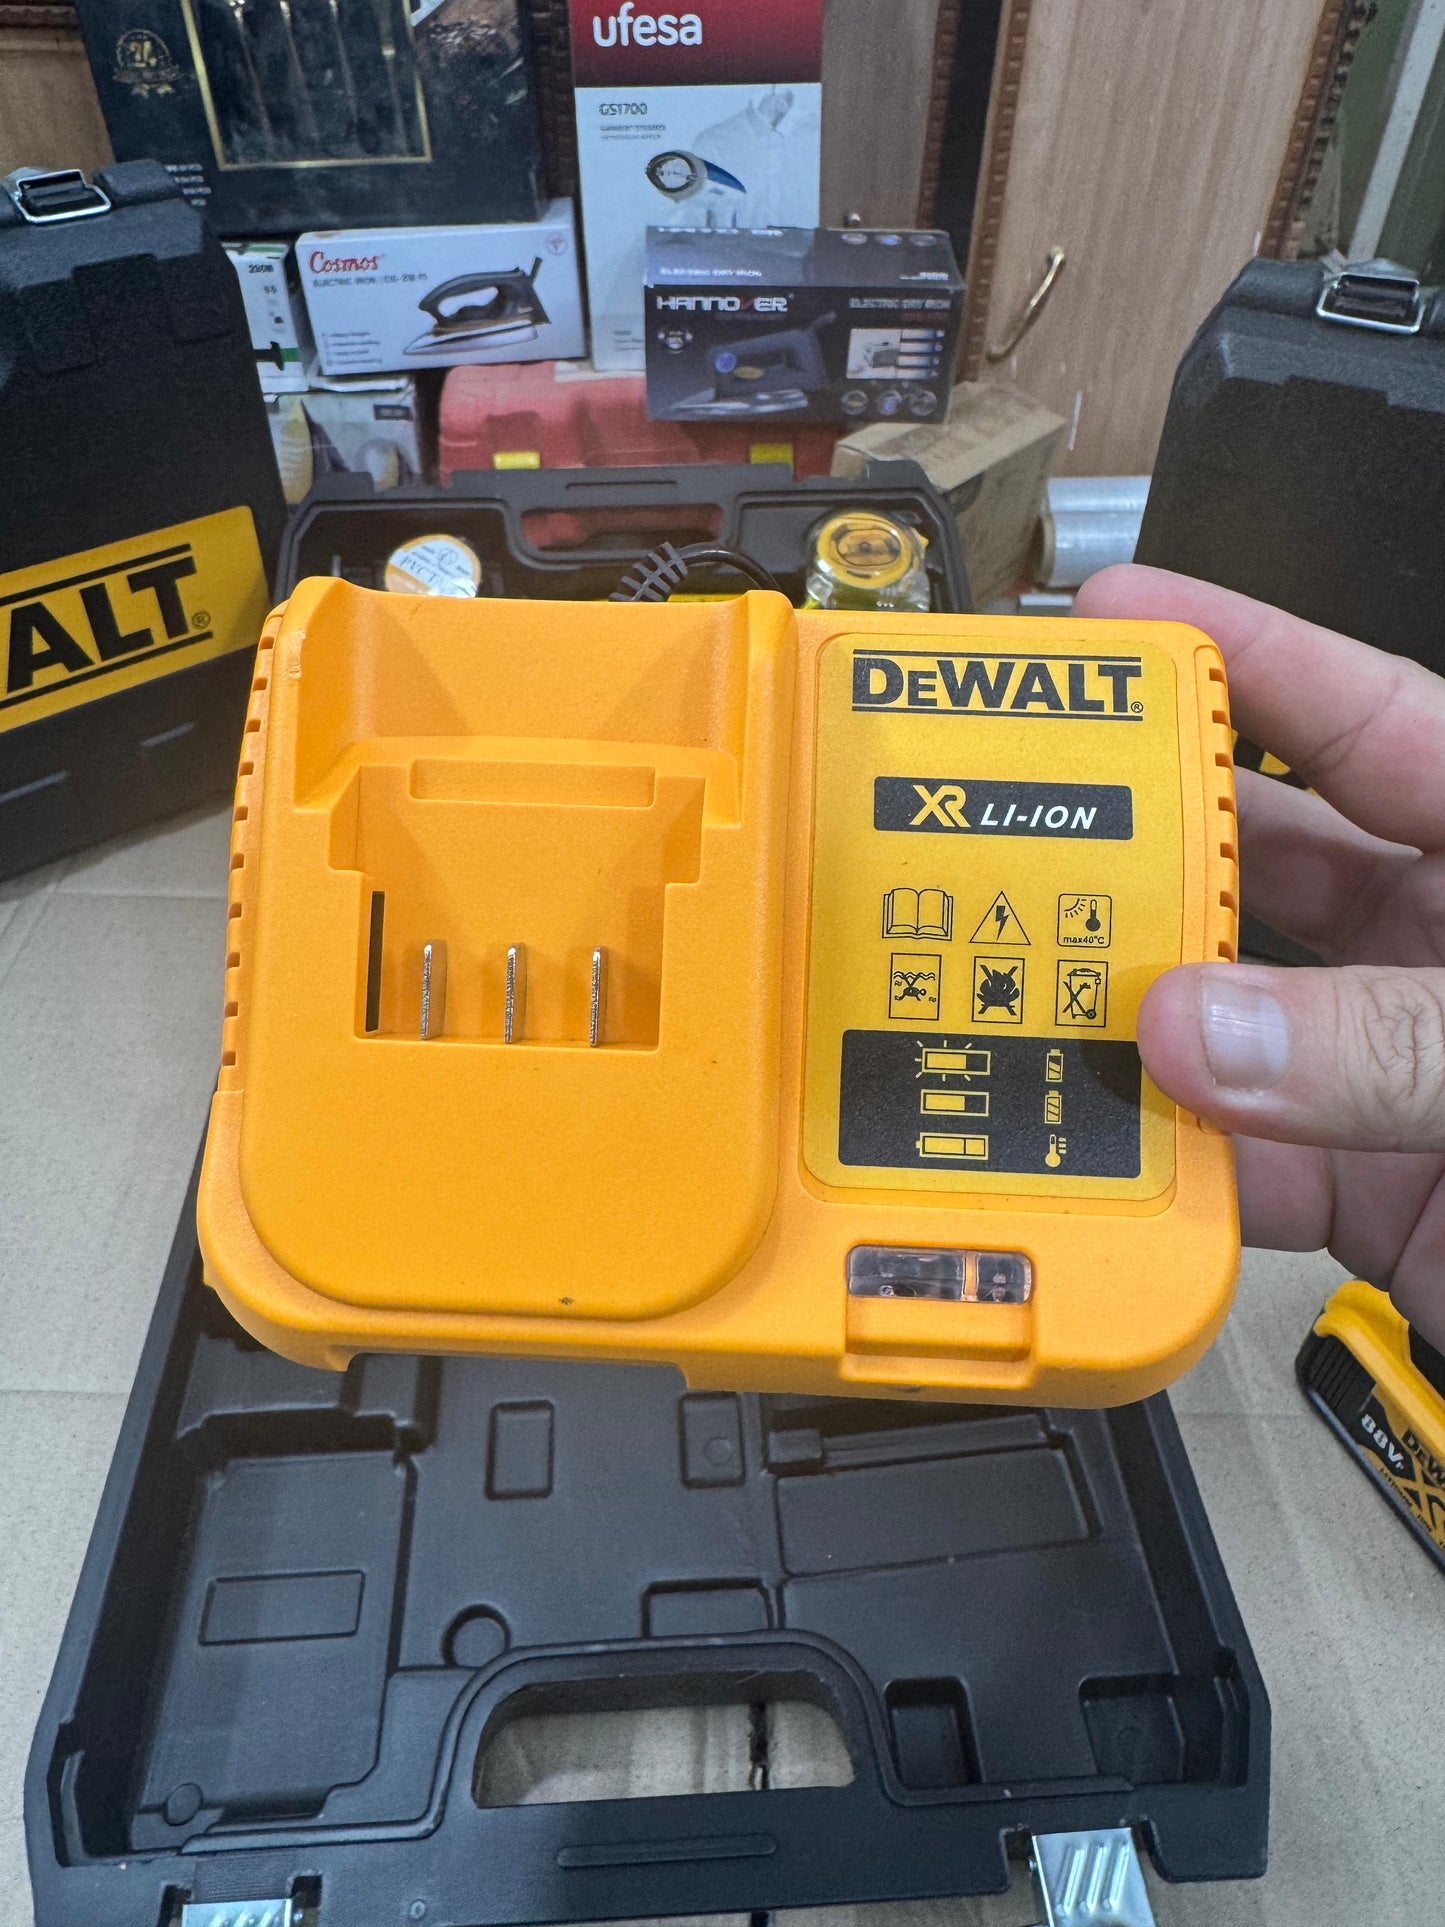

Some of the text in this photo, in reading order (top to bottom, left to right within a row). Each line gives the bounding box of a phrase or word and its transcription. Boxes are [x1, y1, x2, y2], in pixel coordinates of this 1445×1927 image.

[593, 2, 703, 47] ufesa
[599, 102, 648, 116] GS1700
[309, 251, 379, 273] Cosmos
[656, 296, 788, 312] HANNOVER
[852, 657, 1142, 713] DEWALT
[909, 784, 1097, 830] XR LI-ION
